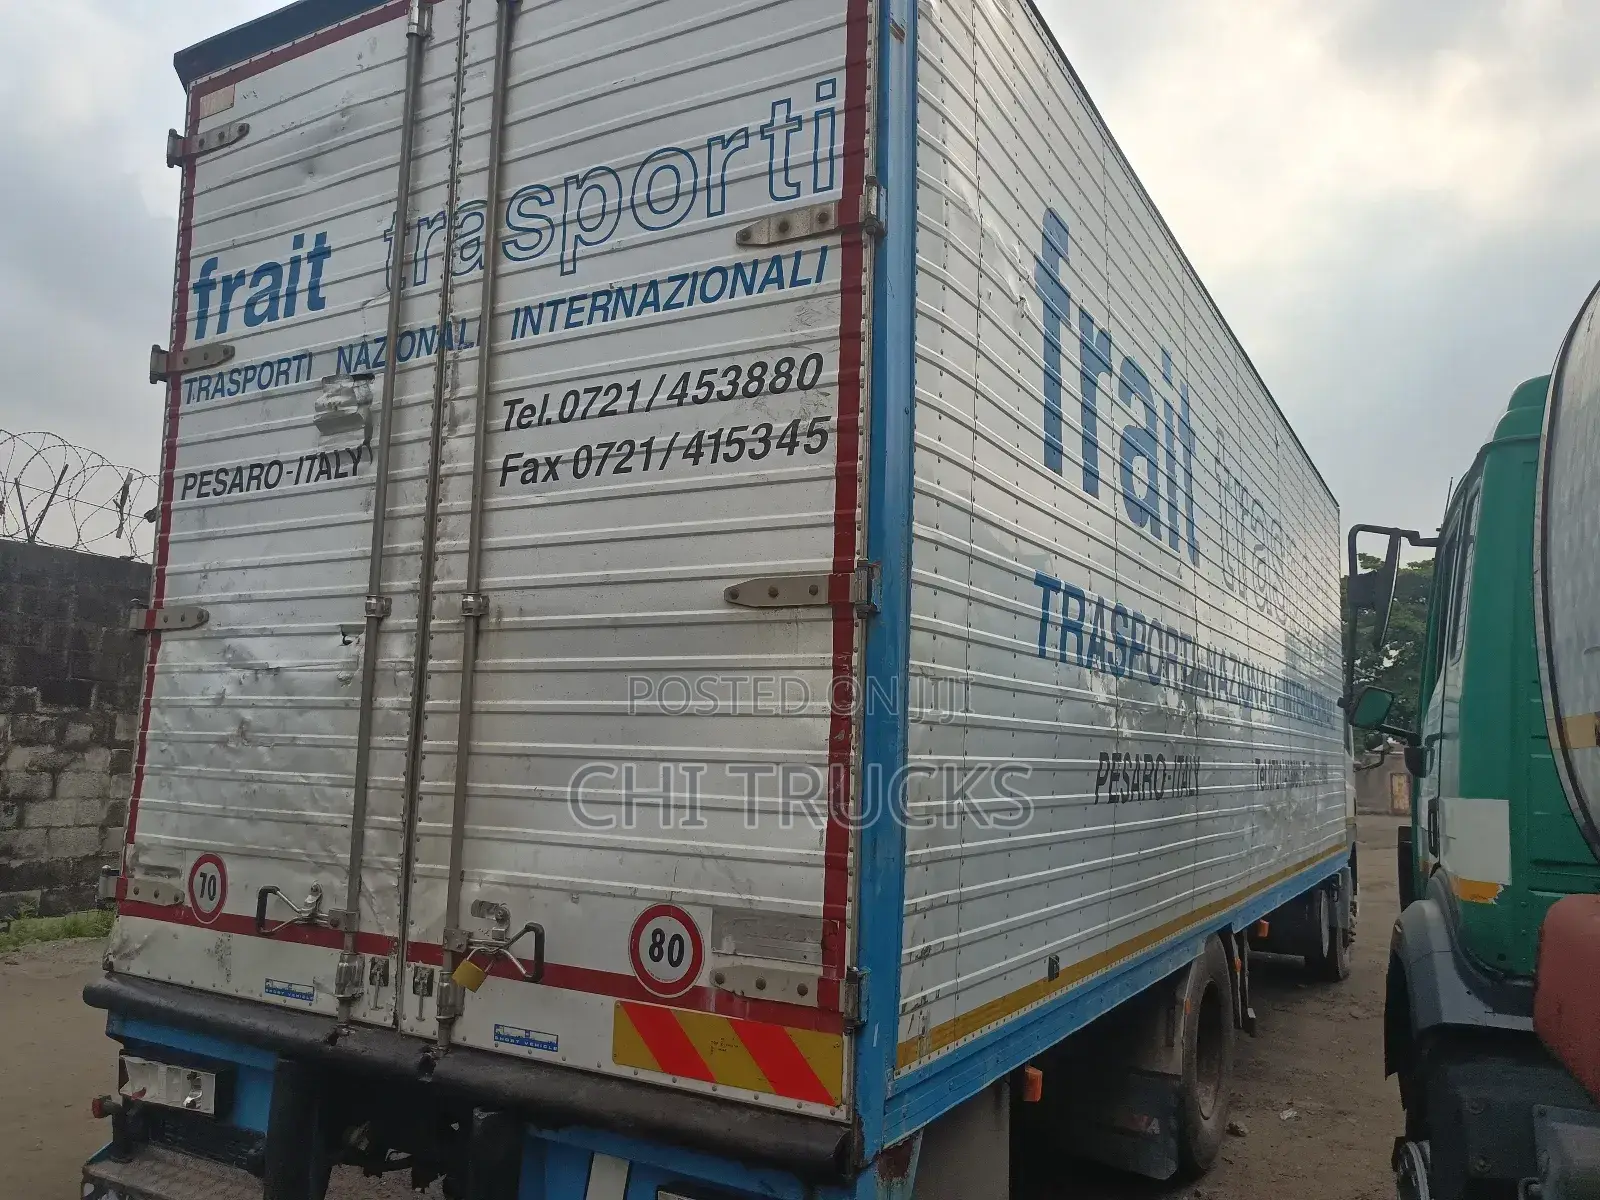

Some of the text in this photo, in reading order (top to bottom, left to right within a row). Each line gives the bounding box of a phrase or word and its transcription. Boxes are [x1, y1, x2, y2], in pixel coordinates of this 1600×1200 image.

[193, 231, 331, 340] frait
[185, 246, 828, 404] TRASPORTI NAZONALI INTERNAZIONALI
[503, 352, 824, 432] Tel.0721/453880
[1034, 207, 1200, 569] frait
[181, 446, 362, 500] PESARO-ITALY
[500, 416, 832, 487] Fax 0721/415345
[199, 871, 217, 902] 70
[648, 927, 685, 968] 80
[494, 1035, 558, 1051] SHORT VEHICLE
